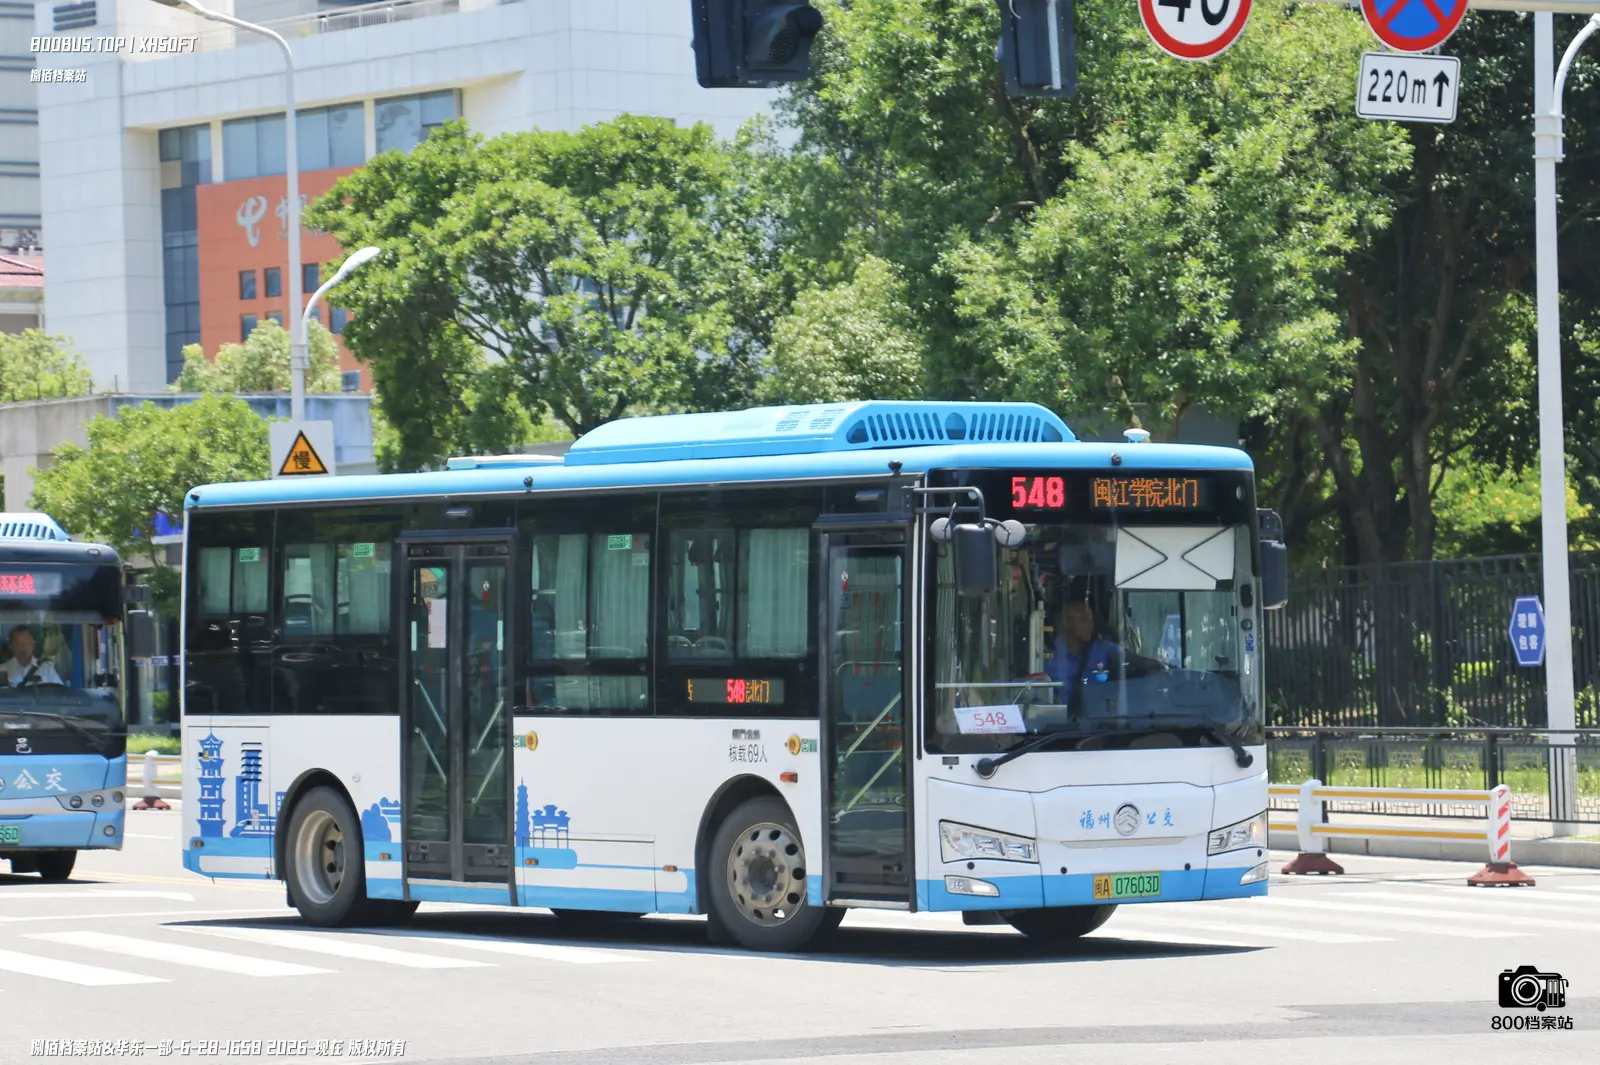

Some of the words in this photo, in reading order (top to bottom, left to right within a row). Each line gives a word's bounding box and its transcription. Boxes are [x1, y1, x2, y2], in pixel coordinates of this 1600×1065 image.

[1367, 68, 1426, 104] 220m
[293, 450, 311, 470] 慢
[1012, 476, 1064, 508] 548
[1094, 477, 1198, 507] 闽江学院北门
[726, 678, 747, 703] 548
[973, 711, 1008, 727] 548
[729, 744, 768, 763] 核载69人
[13, 768, 67, 792] 公交
[1080, 810, 1110, 829] 福州
[1146, 808, 1174, 827] 公交
[1115, 875, 1160, 895] 07603D
